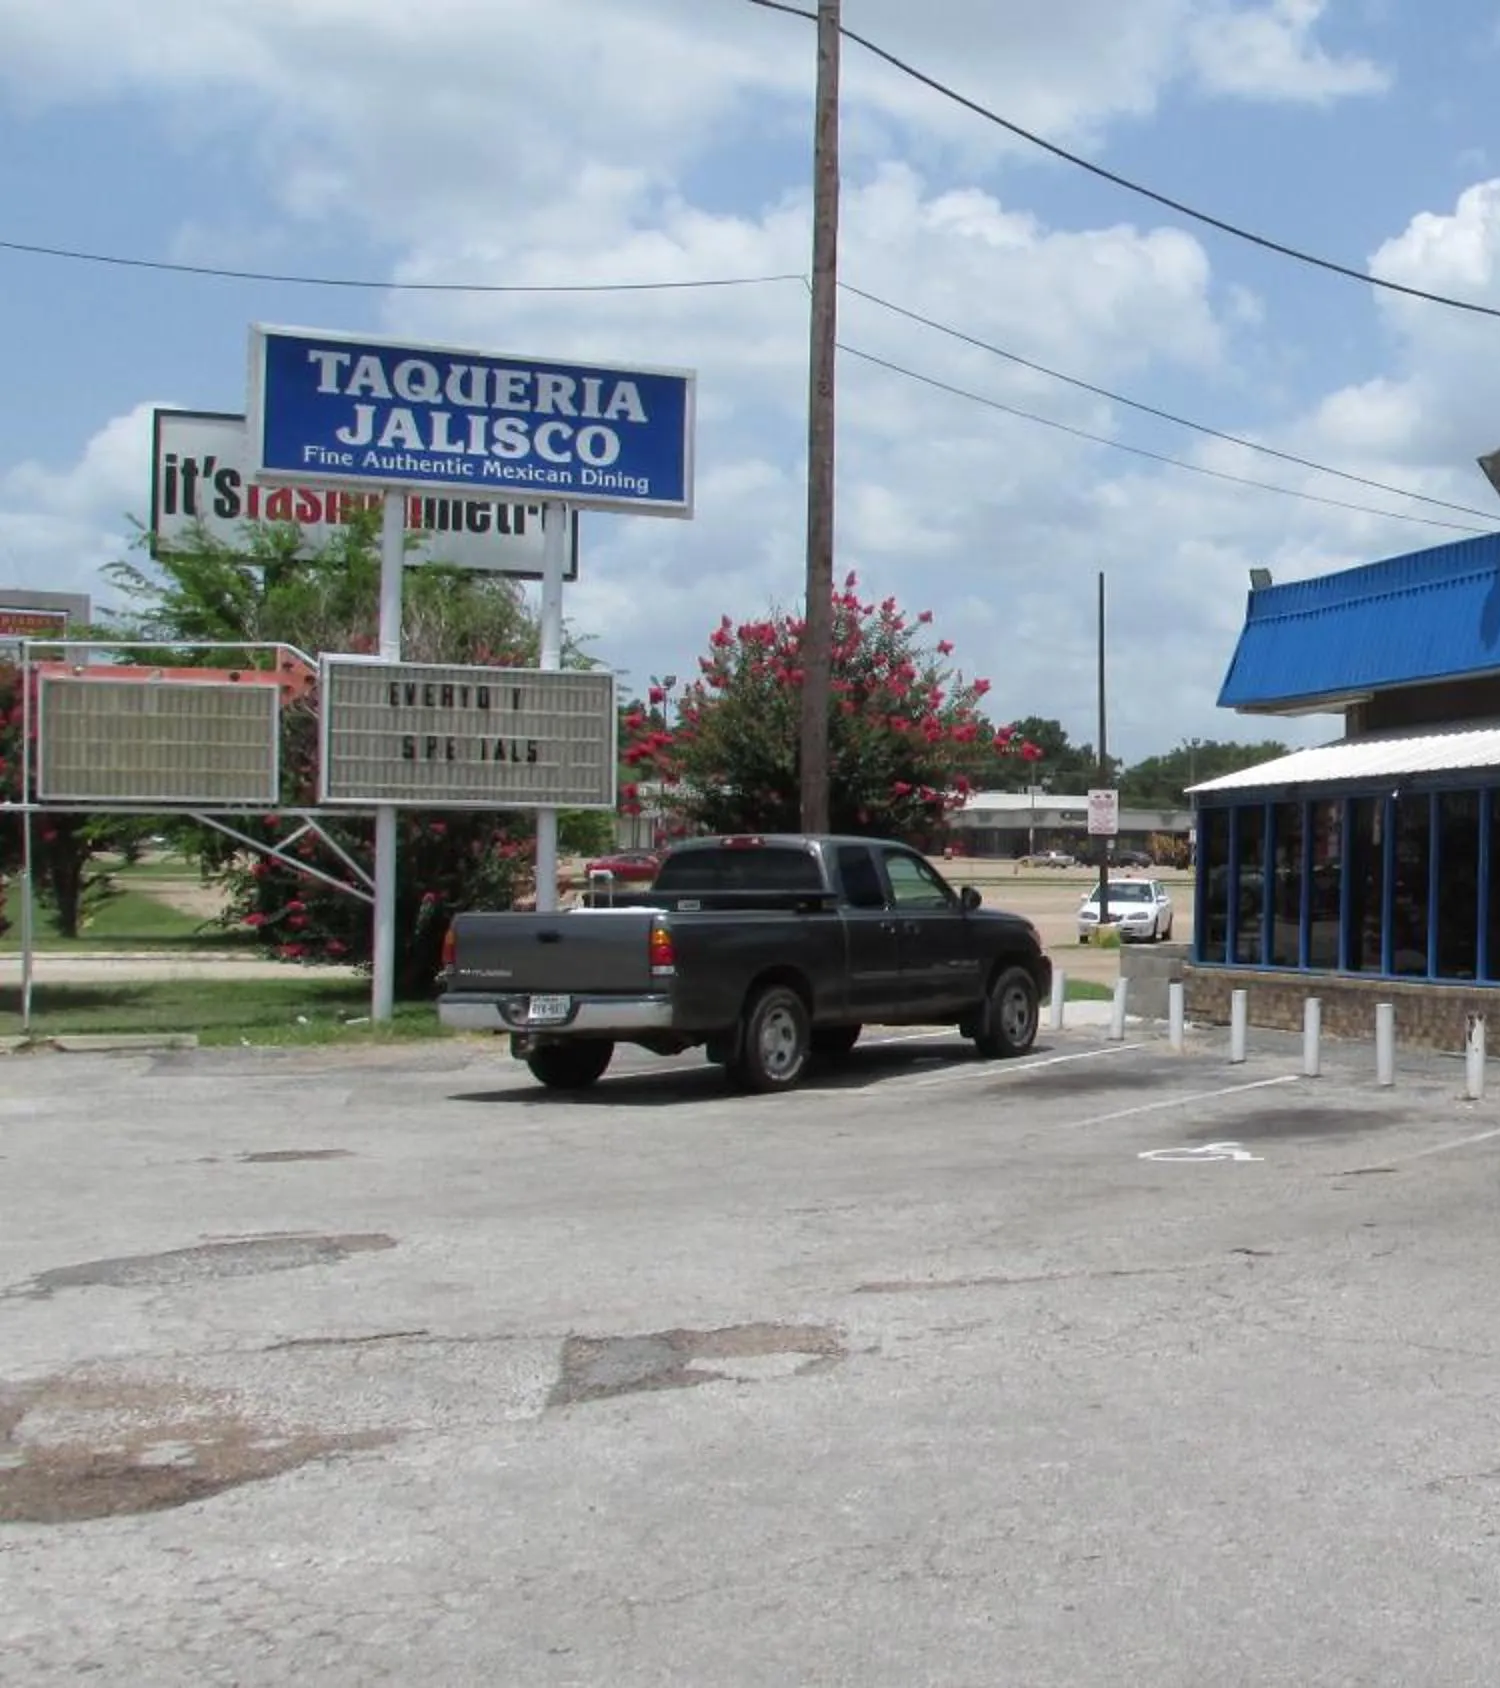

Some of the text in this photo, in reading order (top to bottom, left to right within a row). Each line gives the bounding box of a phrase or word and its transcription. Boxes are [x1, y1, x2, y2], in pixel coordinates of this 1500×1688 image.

[307, 349, 649, 423] TAQUERIA
[335, 403, 621, 467] JALISCO
[164, 453, 241, 518] it's
[303, 445, 650, 495] Fine Authentic Mexican Dining
[402, 734, 538, 763] SPEIALS
